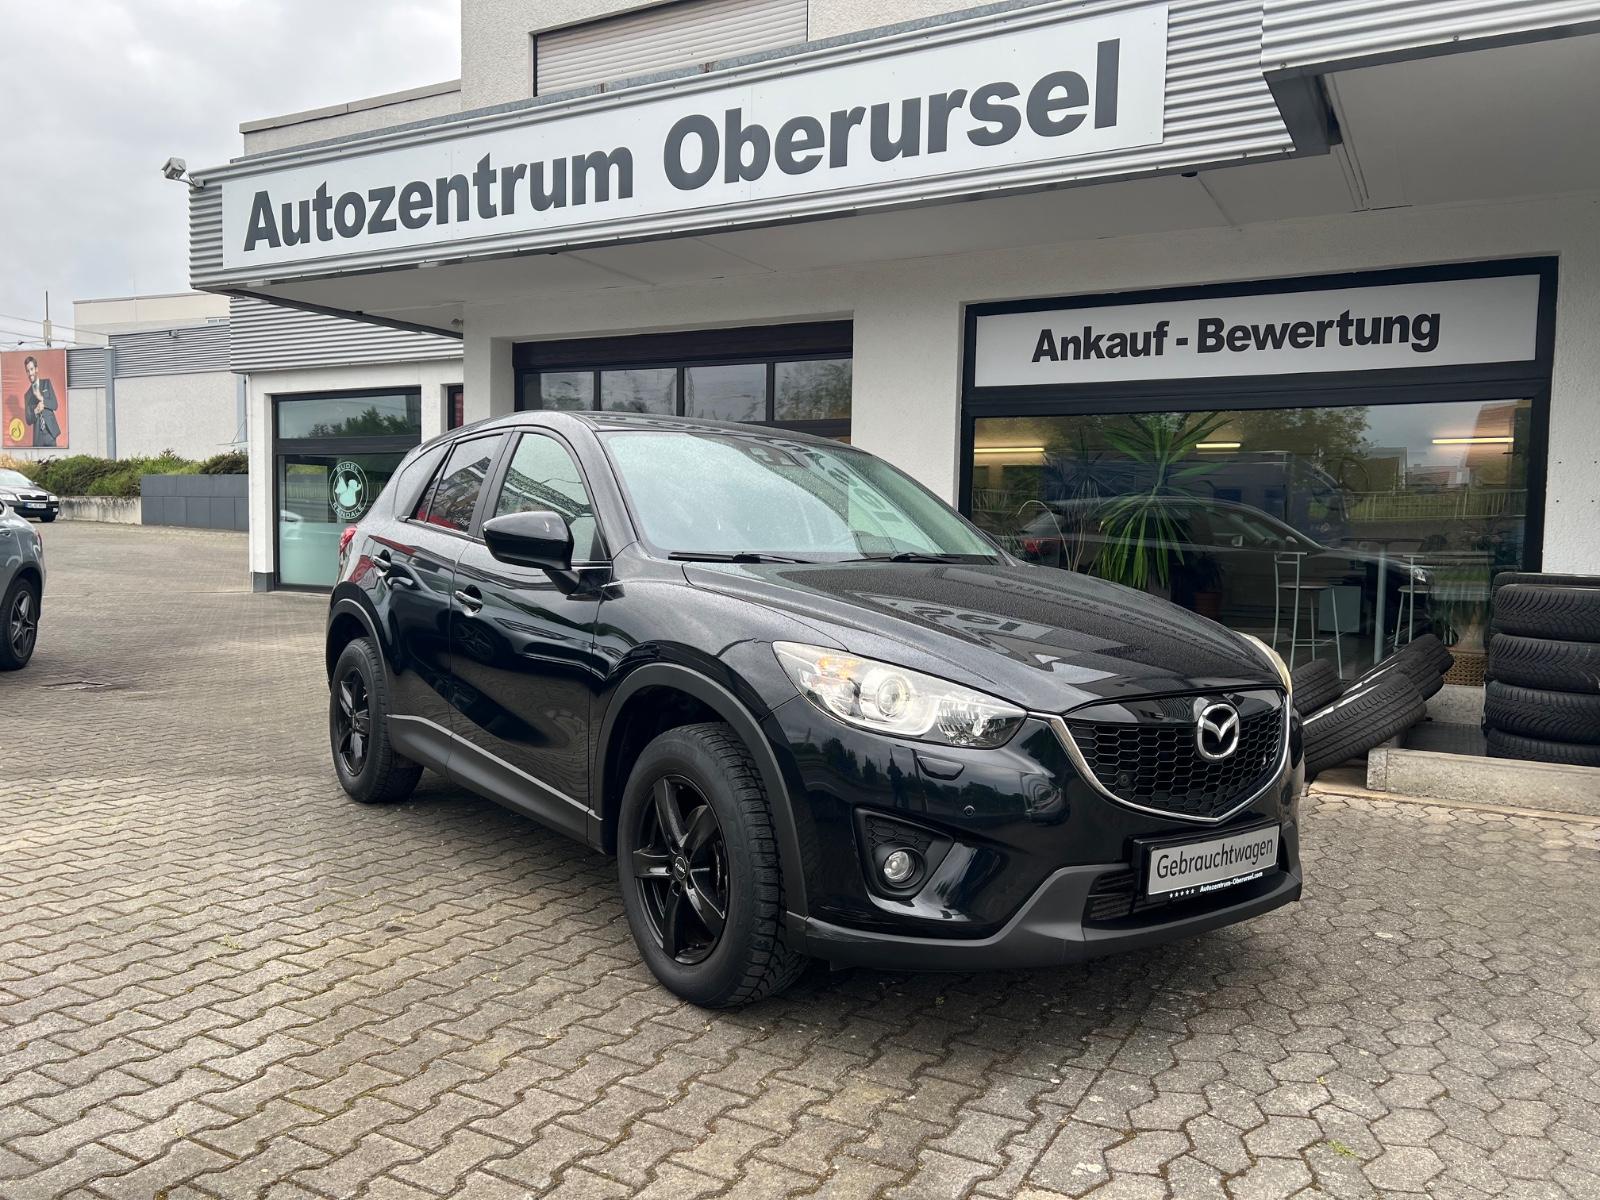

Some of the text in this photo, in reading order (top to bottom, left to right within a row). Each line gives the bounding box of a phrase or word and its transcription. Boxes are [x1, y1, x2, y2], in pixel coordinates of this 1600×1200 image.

[243, 38, 1121, 252] Autozentrum Oberursel
[1031, 320, 1169, 362] Ankauf
[1197, 310, 1441, 353] Bewertung
[1156, 838, 1273, 879] Gebrauchtwagen
